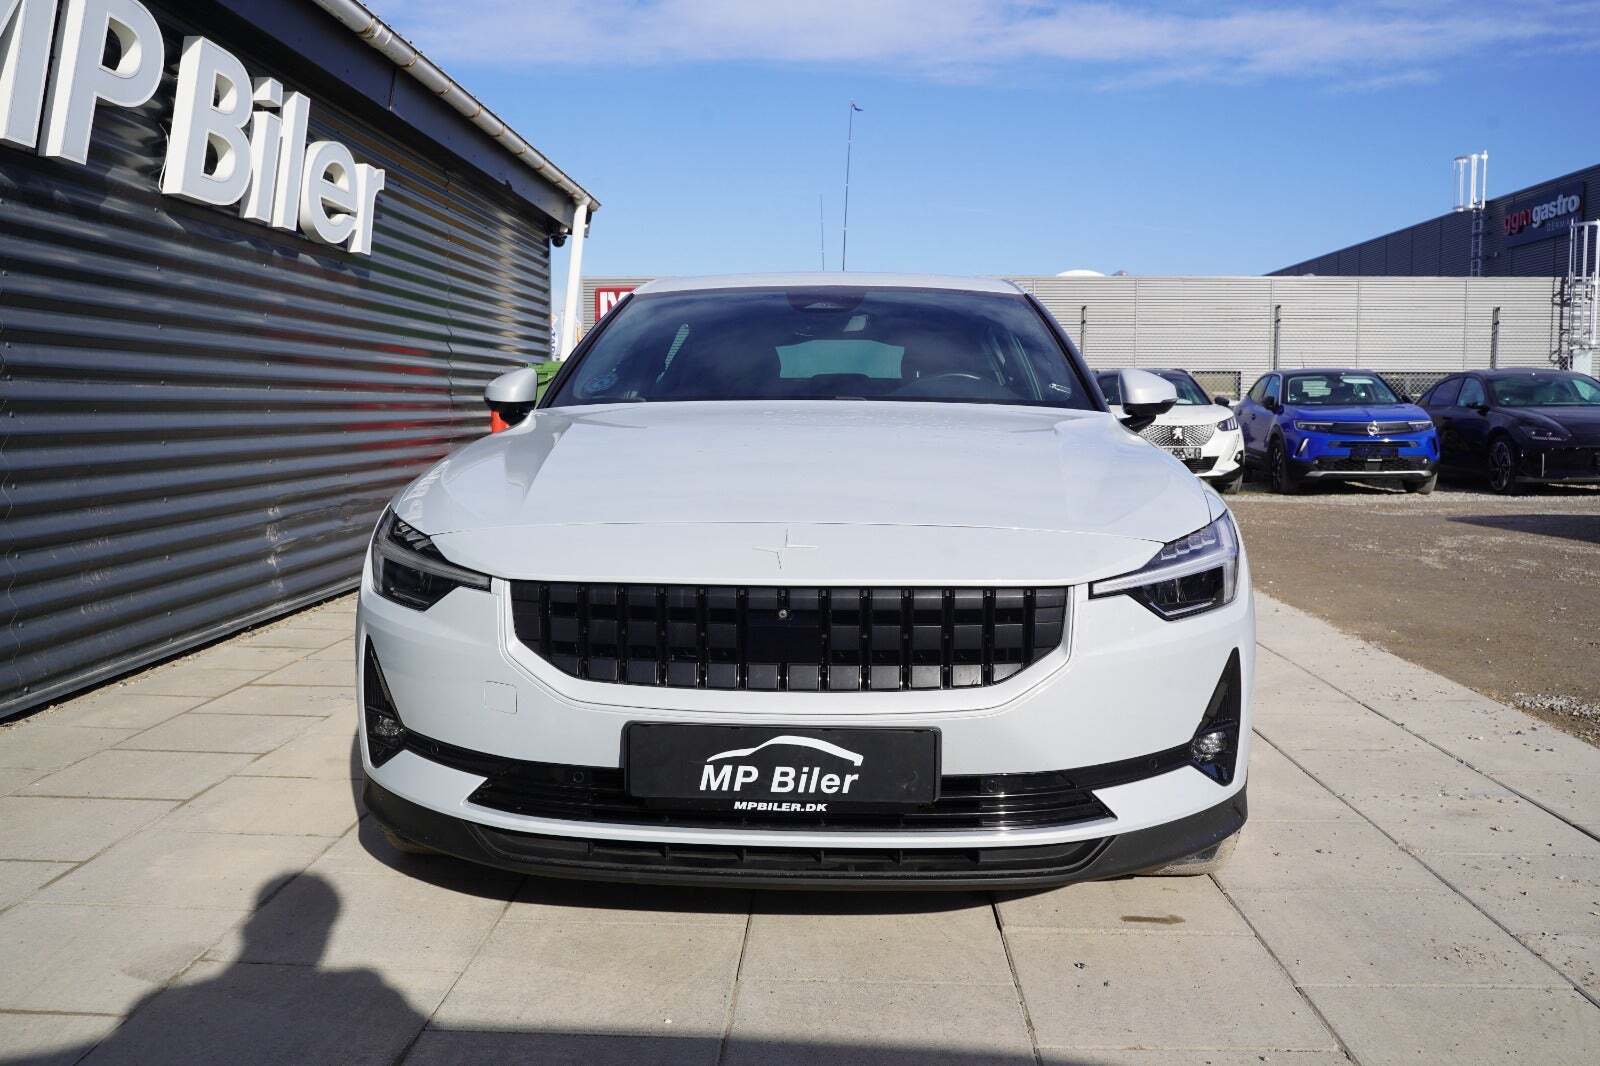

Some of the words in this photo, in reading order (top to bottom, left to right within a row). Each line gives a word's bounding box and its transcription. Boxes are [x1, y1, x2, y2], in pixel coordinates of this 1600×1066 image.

[162, 35, 386, 255] Biler
[700, 765, 759, 791] MP
[771, 767, 859, 794] Biler
[733, 801, 828, 812] MPBILER.DK
